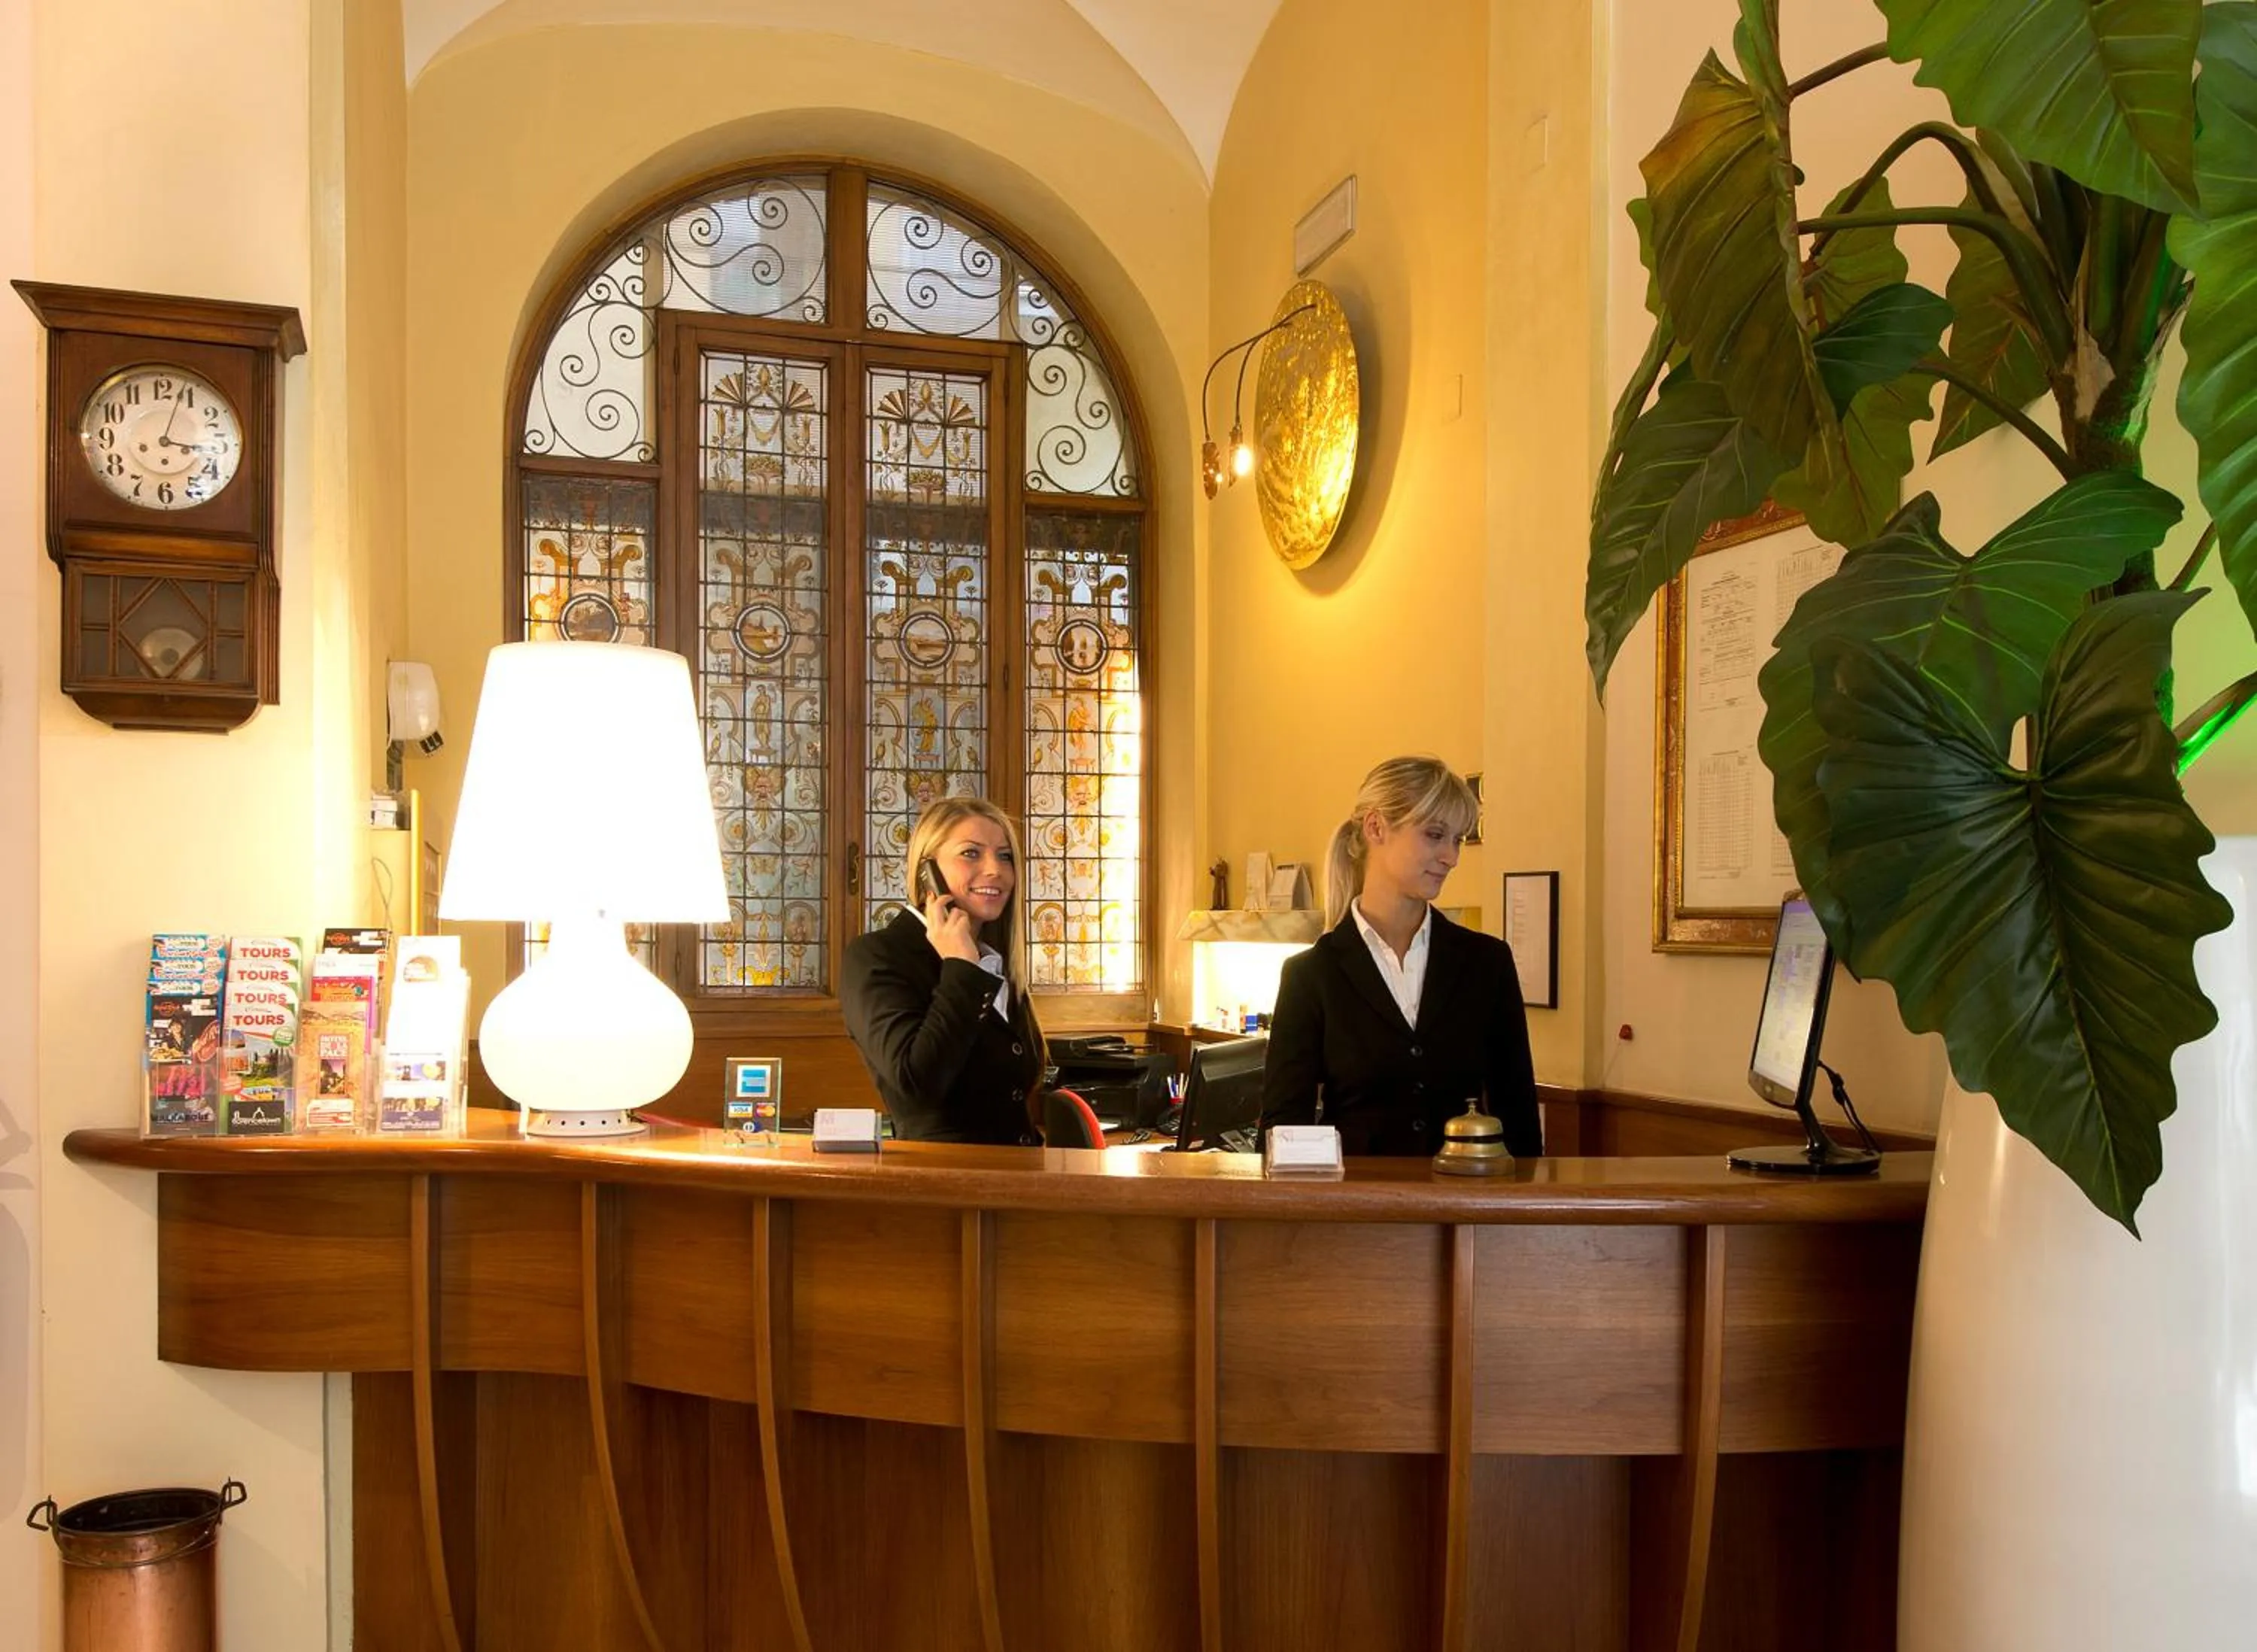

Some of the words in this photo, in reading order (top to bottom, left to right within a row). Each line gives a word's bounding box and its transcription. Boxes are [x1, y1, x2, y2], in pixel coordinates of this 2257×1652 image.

[126, 384, 141, 405] 11
[153, 378, 172, 400] 12
[187, 387, 194, 408] 1
[104, 402, 124, 424] 10
[204, 406, 219, 428] 2
[99, 427, 114, 449] 9
[107, 454, 124, 476] 8
[201, 457, 218, 480] 4
[130, 475, 143, 497] 7
[157, 481, 174, 504] 6
[186, 476, 202, 498] 5
[240, 947, 291, 958] TOURS
[236, 970, 289, 980] TOURS
[234, 992, 287, 1004] TOURS
[232, 1014, 285, 1025] TOURS
